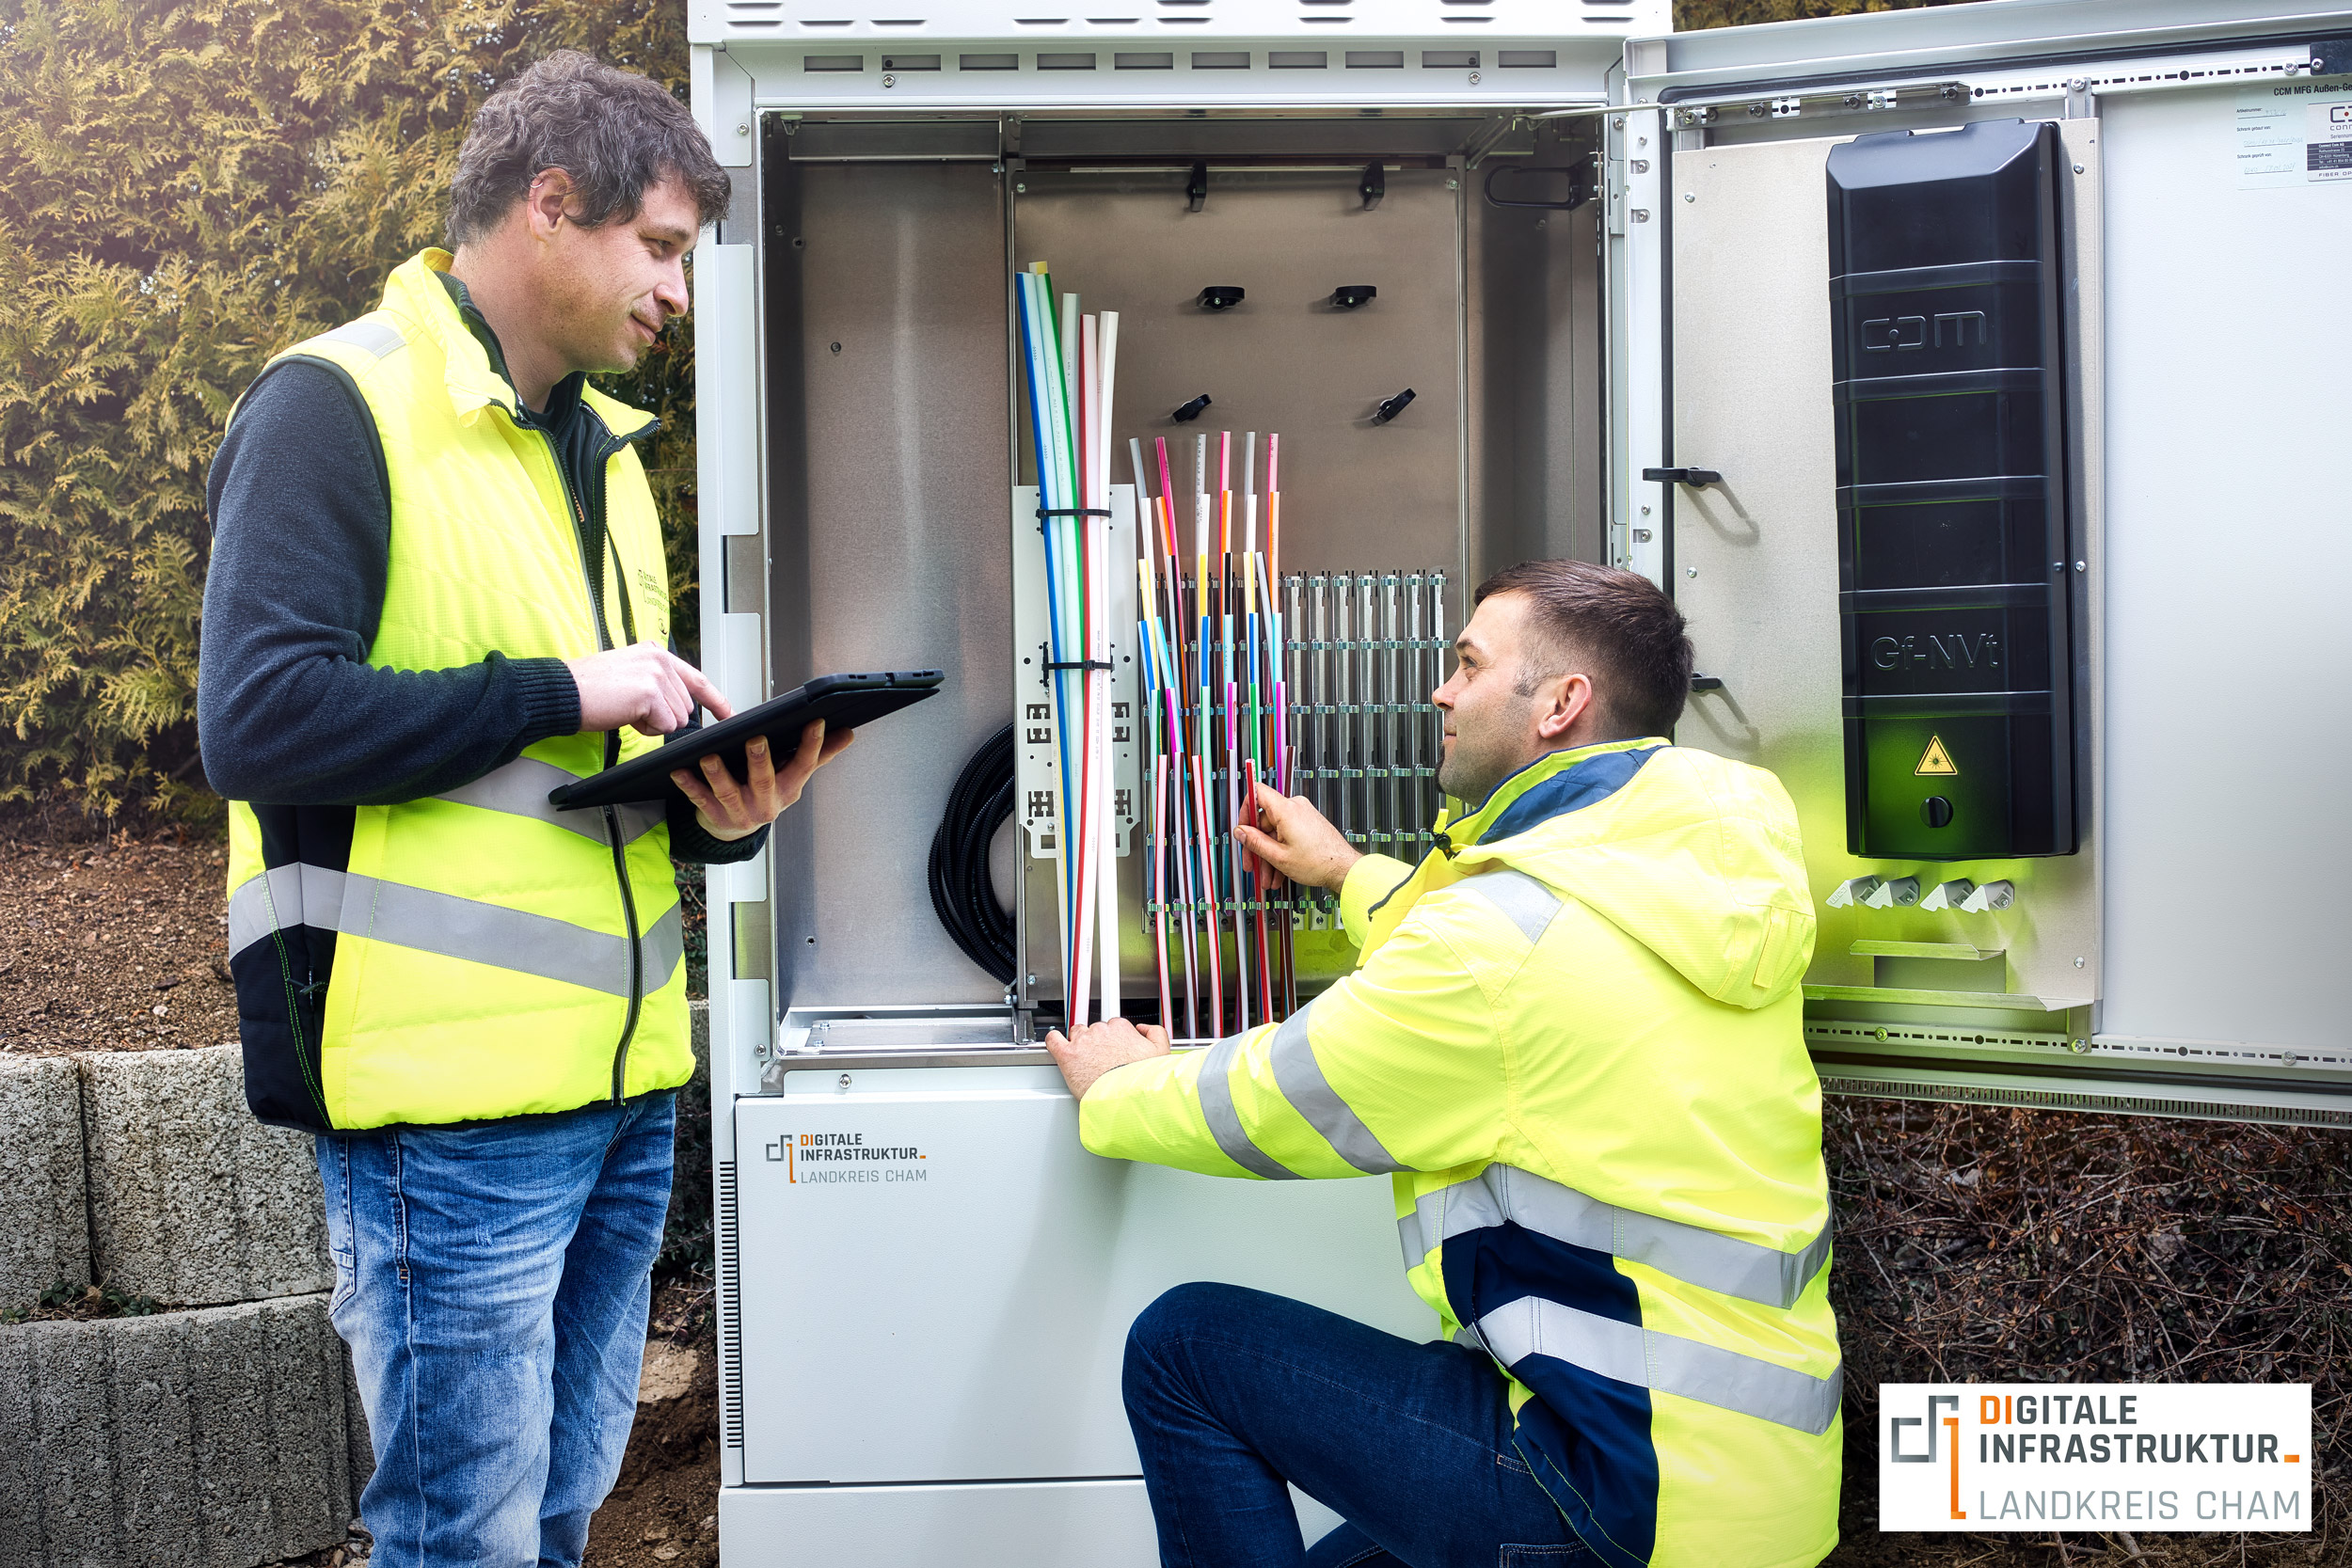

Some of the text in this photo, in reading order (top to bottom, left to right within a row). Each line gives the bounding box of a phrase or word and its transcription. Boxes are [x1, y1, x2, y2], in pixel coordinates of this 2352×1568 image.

[2274, 87, 2292, 96] CCM
[2294, 86, 2312, 95] MFG
[1869, 633, 1998, 672] Gf-NVt
[801, 1133, 863, 1146] DIGITALE
[801, 1169, 927, 1183] LANDKREIS CHAM
